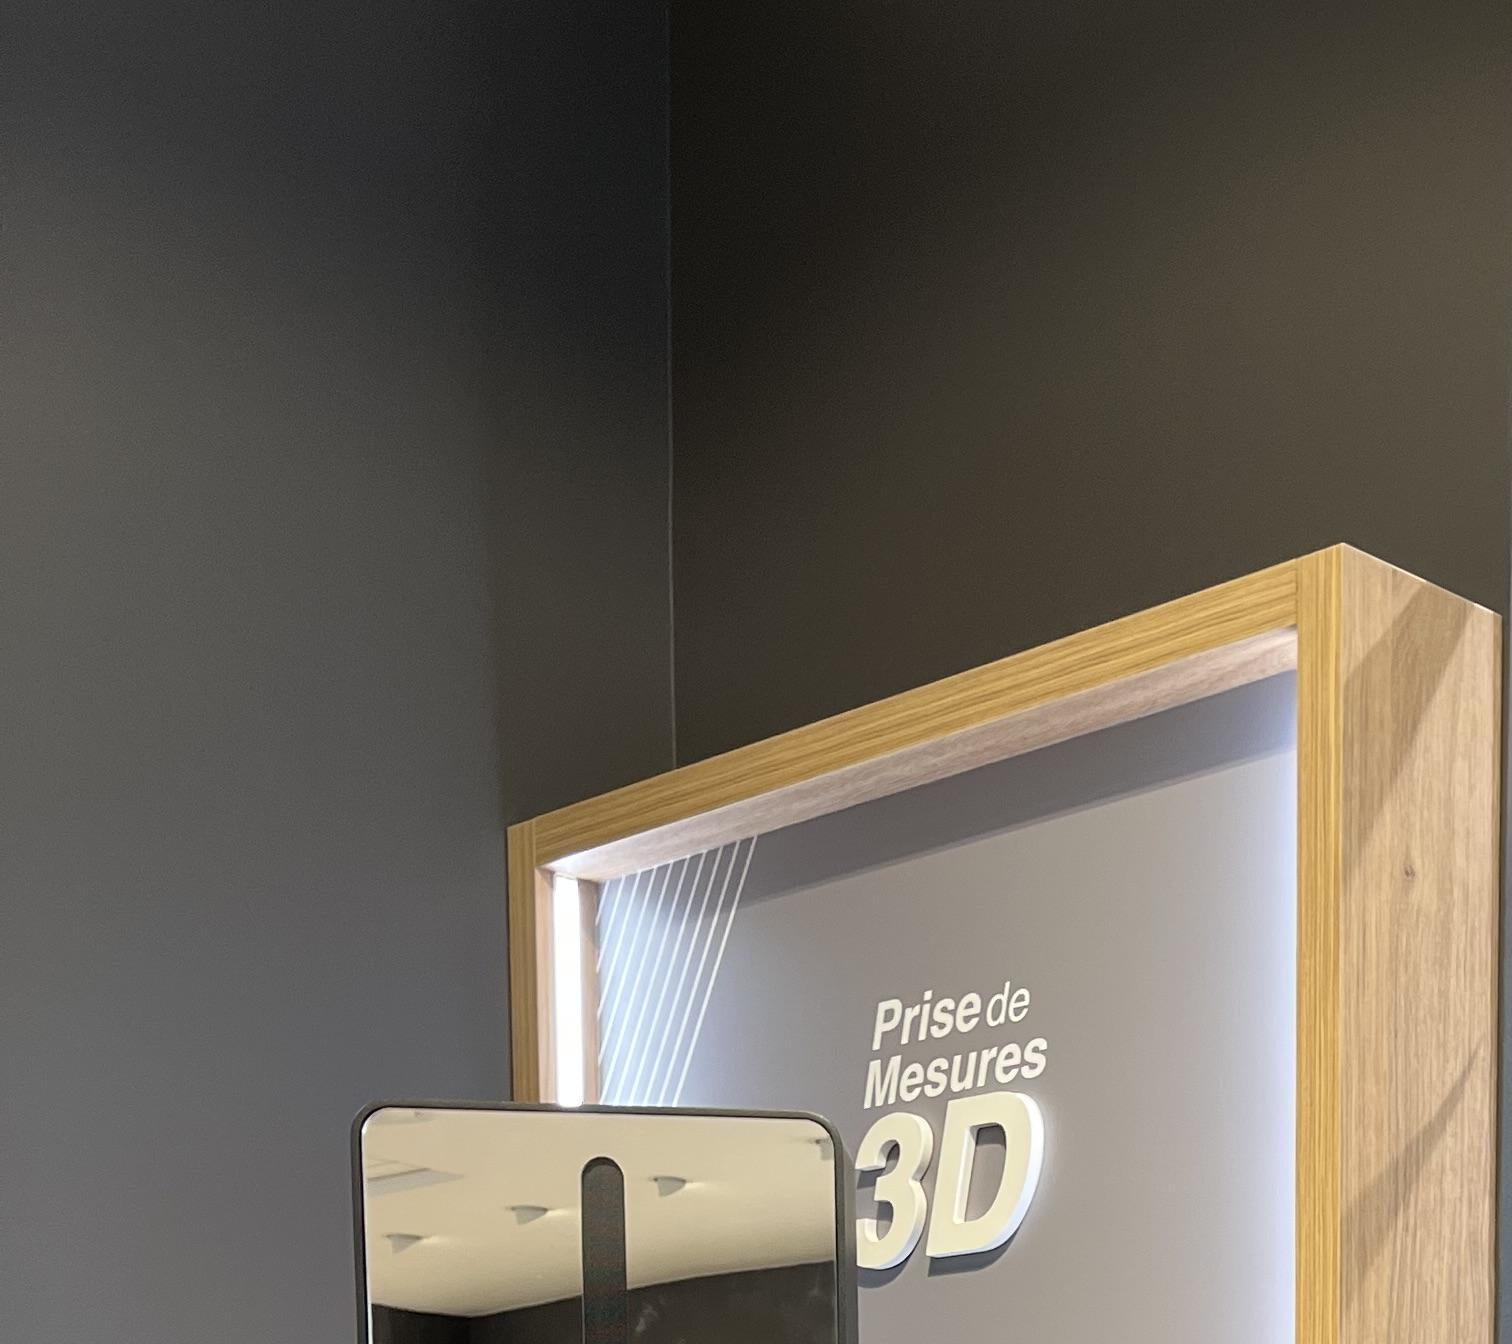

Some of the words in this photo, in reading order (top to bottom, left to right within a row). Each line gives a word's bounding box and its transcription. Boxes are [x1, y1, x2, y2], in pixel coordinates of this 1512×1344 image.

[872, 989, 982, 1051] Prise
[986, 980, 1031, 1027] de
[863, 1037, 1048, 1110] Mesures
[855, 1091, 1044, 1271] 3D
